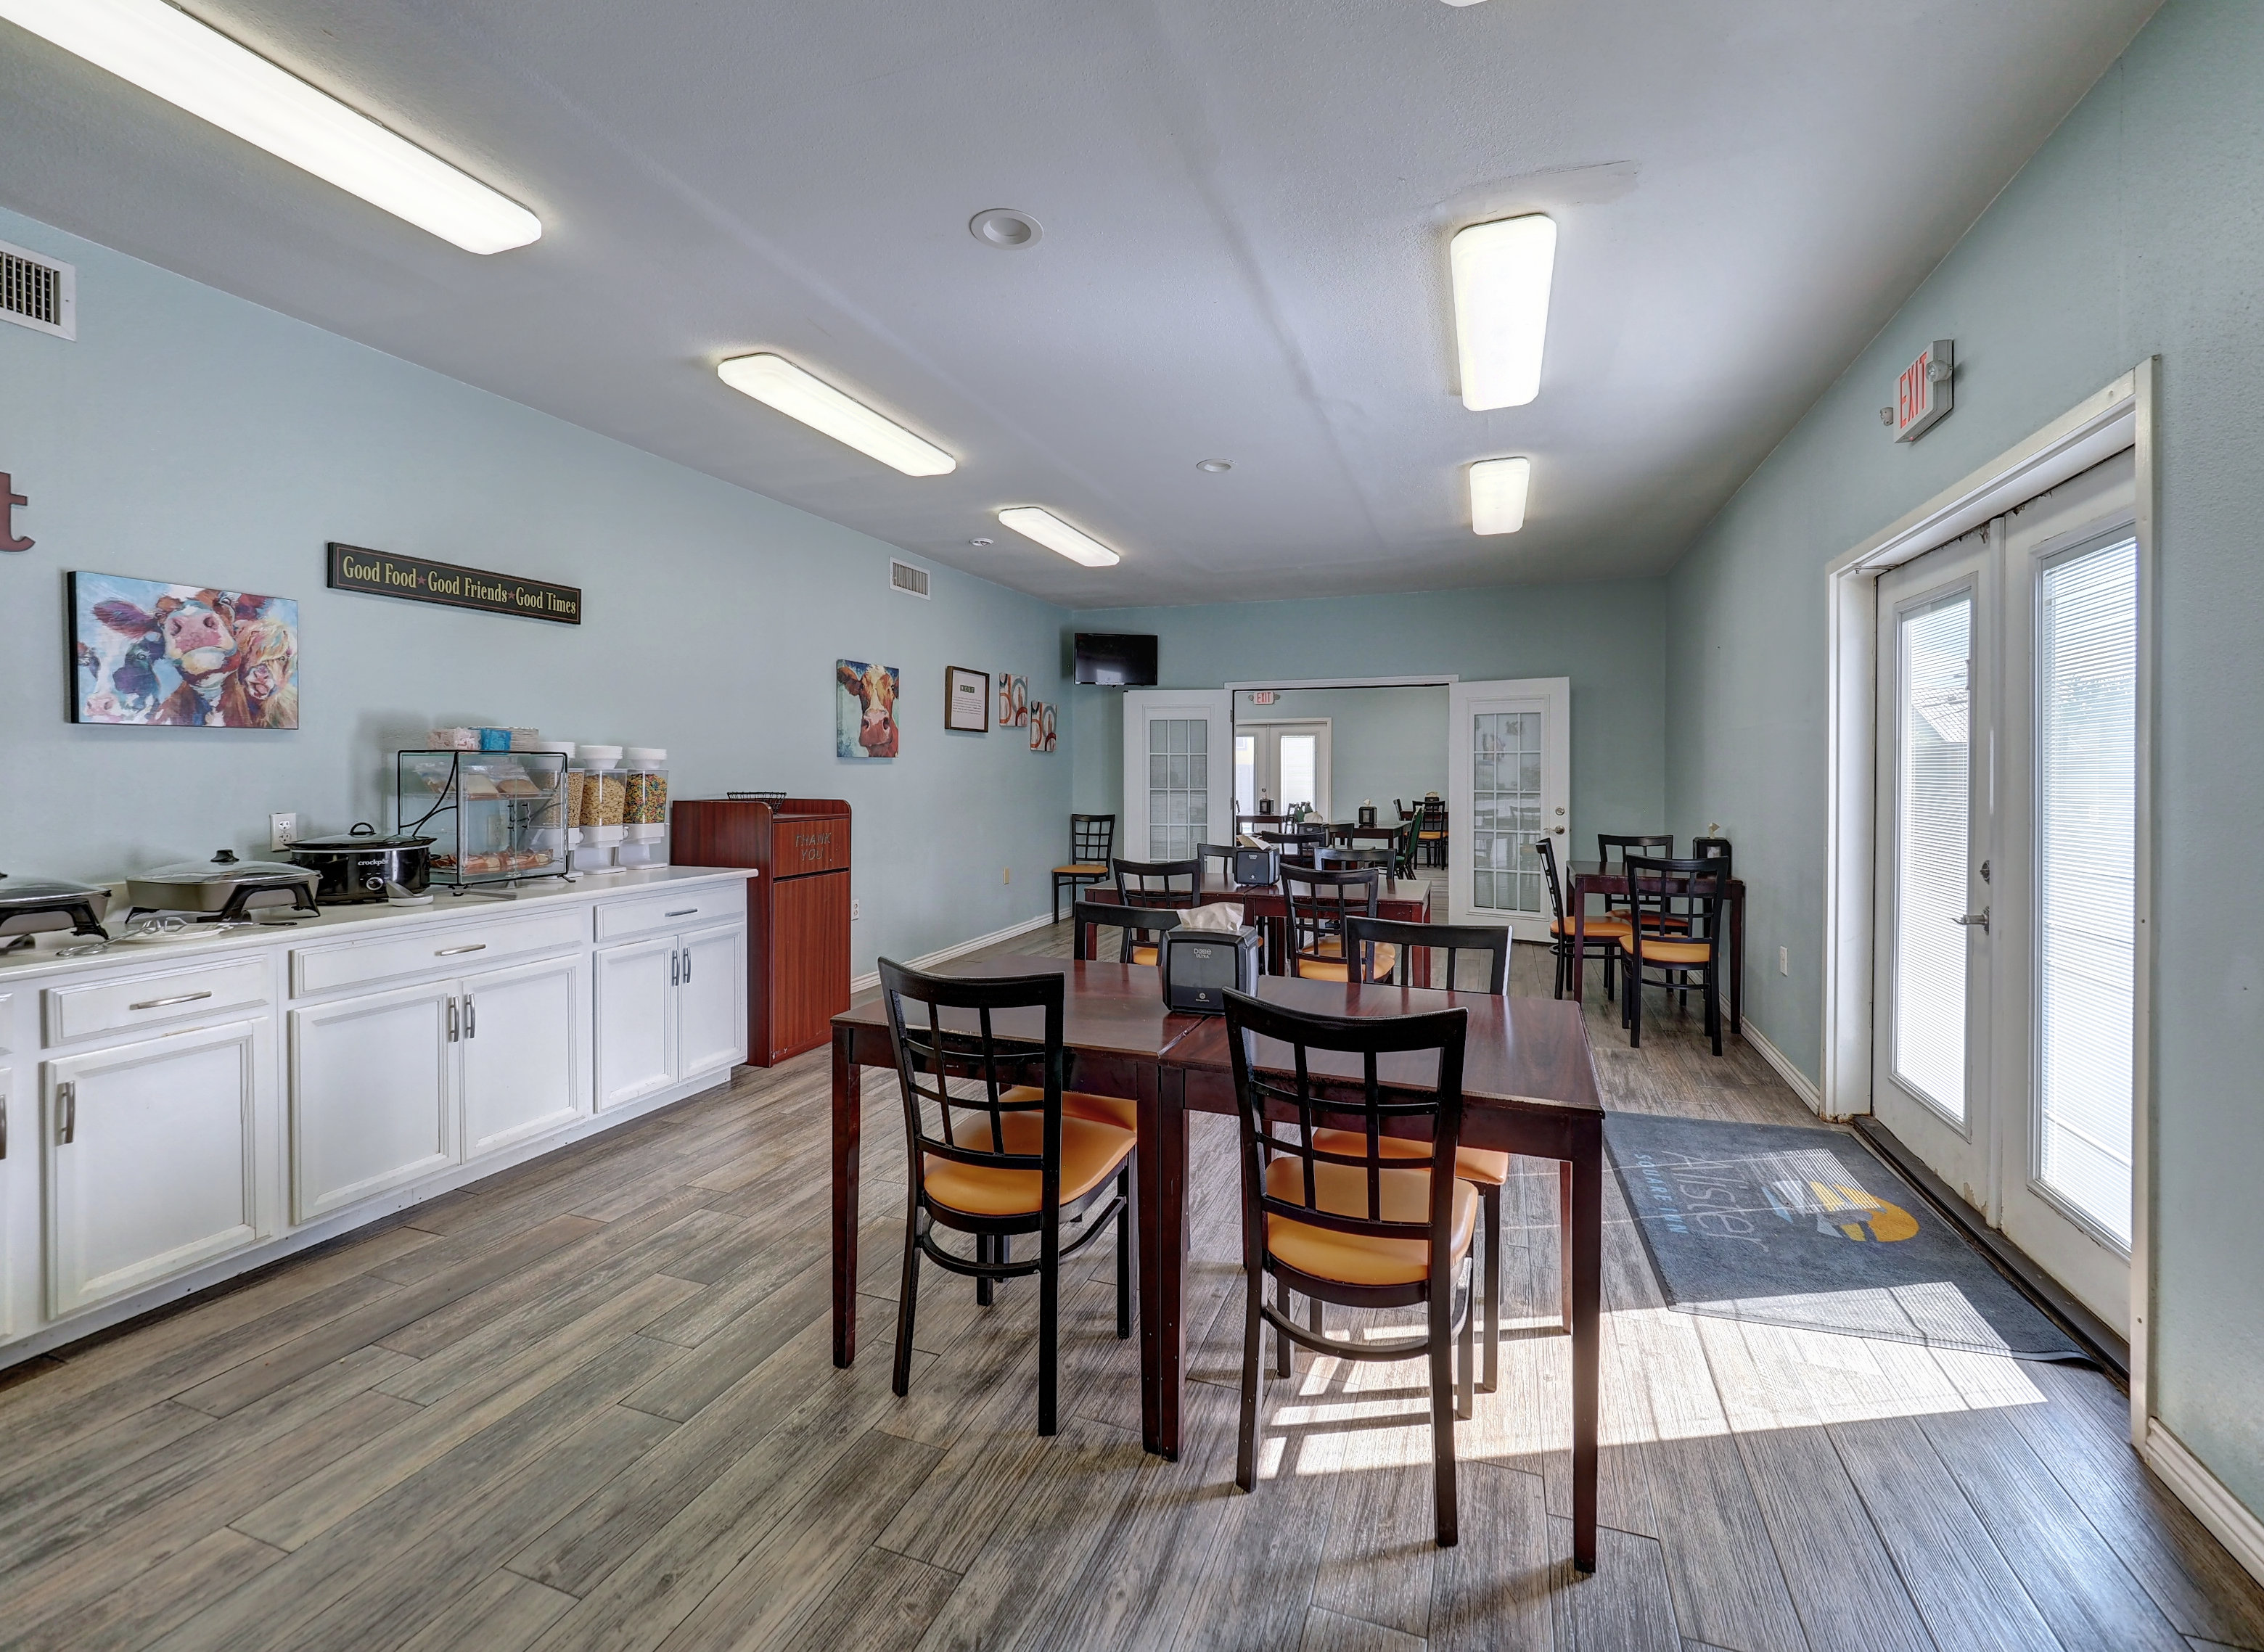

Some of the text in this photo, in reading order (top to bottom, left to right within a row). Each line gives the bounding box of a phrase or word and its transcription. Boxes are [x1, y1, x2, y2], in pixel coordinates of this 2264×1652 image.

[1900, 350, 1928, 430] EXIT
[343, 556, 576, 615] Good Food Good Friends Good Times
[1257, 691, 1271, 703] EXIT
[795, 832, 832, 847] THANK
[801, 847, 824, 861] YOU
[1634, 1153, 1689, 1234] SQUARE INN
